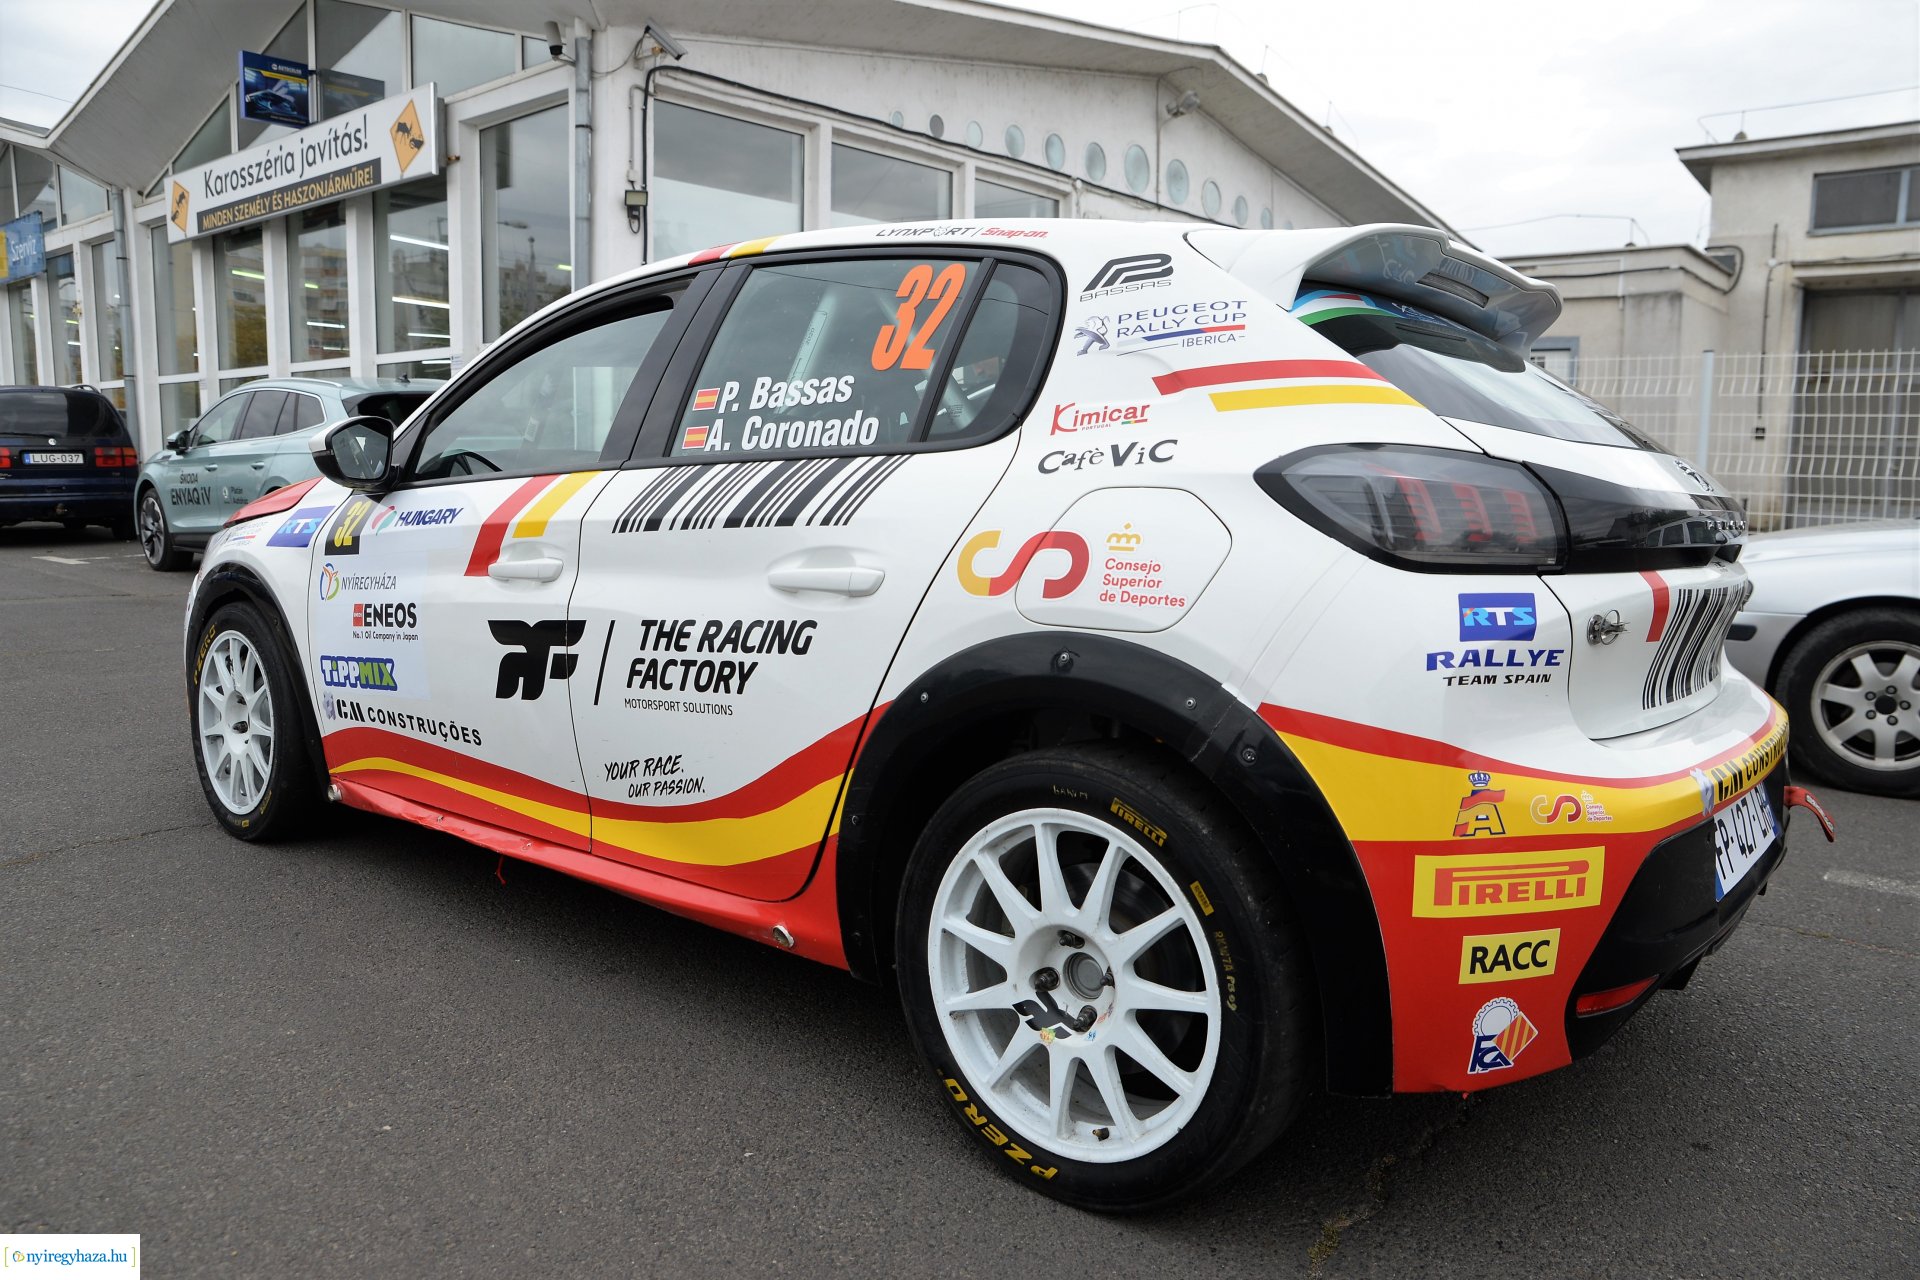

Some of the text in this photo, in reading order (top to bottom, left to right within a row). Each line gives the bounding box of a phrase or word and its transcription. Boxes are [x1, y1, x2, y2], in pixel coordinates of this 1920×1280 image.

[204, 114, 369, 199] Karosszéria javítás!
[202, 165, 374, 231] MINDEN SZEMÉLY ÉS HASZONJÁRMŰRE!
[1080, 279, 1172, 302] BASSAS
[871, 263, 967, 371] 32
[1116, 312, 1247, 338] RALLY CUP
[1117, 300, 1247, 325] PEUGEOT
[1182, 333, 1236, 348] IBERICA
[718, 374, 855, 414] P. Bassas
[703, 409, 880, 452] A. Coronado
[1050, 402, 1151, 436] Kimicar
[32, 454, 80, 463] LUG-037
[170, 487, 201, 506] ENYAQ
[201, 486, 211, 505] iV
[279, 517, 322, 534] RTS
[334, 501, 373, 548] 32
[394, 507, 464, 527] HUNGARY
[1104, 558, 1162, 575] Consejo
[341, 572, 397, 590] NYÍREGYHÁZA
[1102, 573, 1163, 590] Superior
[1099, 589, 1186, 608] de Deportes
[363, 602, 417, 628] ENEOS
[1462, 607, 1536, 627] RTS
[373, 631, 395, 642] Company
[402, 632, 419, 643] Japan
[640, 618, 818, 656] THE RACING
[1426, 648, 1565, 672] RALLYE
[626, 657, 759, 695] FACTORY
[1442, 673, 1552, 687] TEAM SPAIN
[624, 697, 733, 716] MOTORSPORT SOLUTIONS
[367, 706, 482, 746] CONSTRUÇÕES
[604, 754, 684, 782] YOUR RACE.
[628, 776, 706, 798] OUR PASSION.
[1110, 797, 1168, 847] PIRELLI
[1433, 859, 1590, 906] PIRELLI
[1469, 939, 1551, 975] RACC
